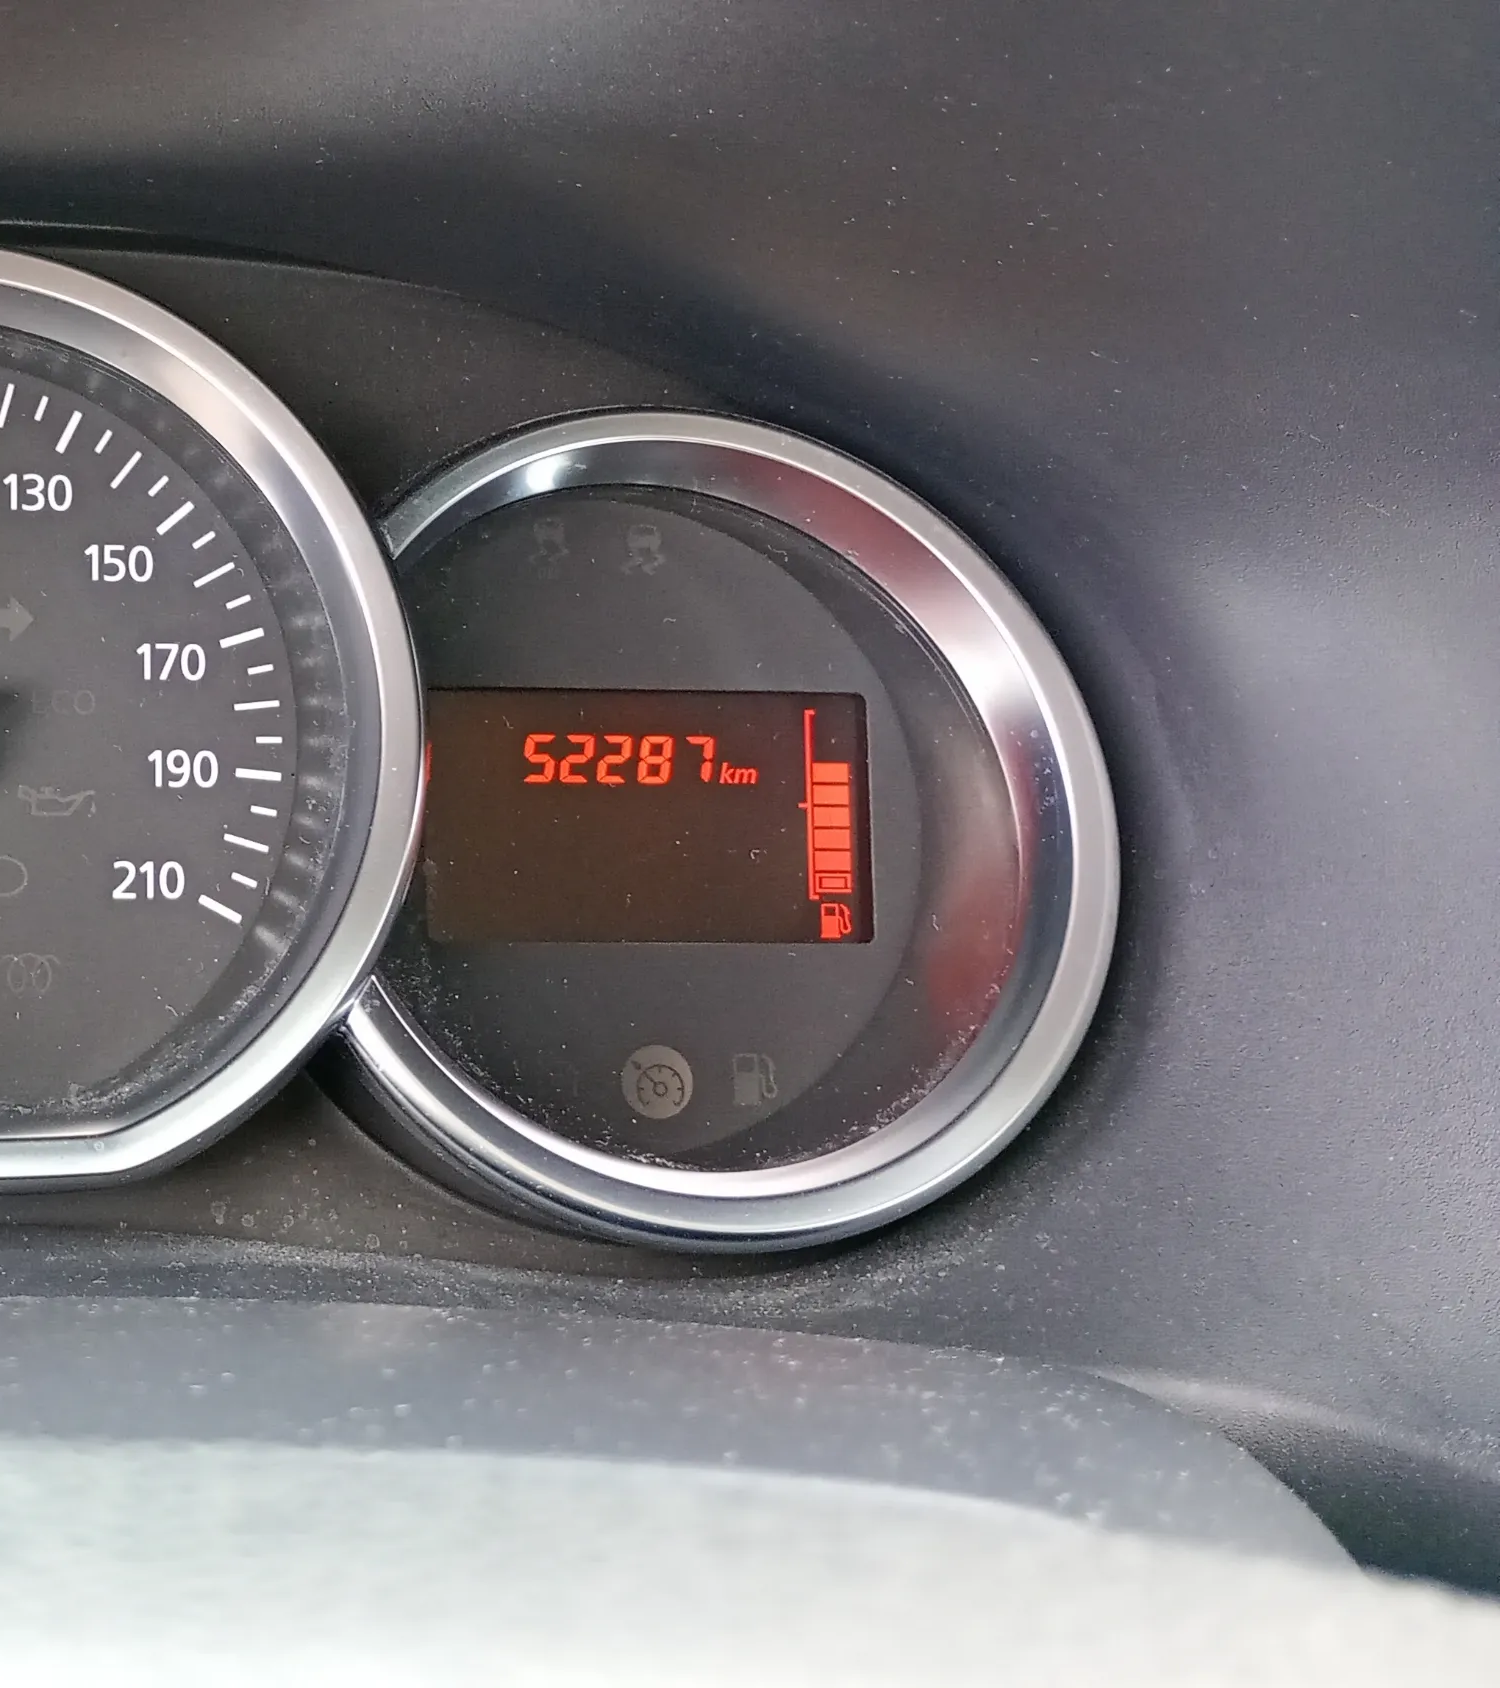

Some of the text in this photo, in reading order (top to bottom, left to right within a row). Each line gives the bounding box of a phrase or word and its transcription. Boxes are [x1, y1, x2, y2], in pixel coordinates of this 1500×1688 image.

[2, 473, 73, 512] 130
[84, 544, 154, 583] 150
[136, 643, 206, 682] 170
[147, 749, 219, 789] 190
[523, 733, 759, 785] 52287 km
[112, 860, 185, 900] 210
